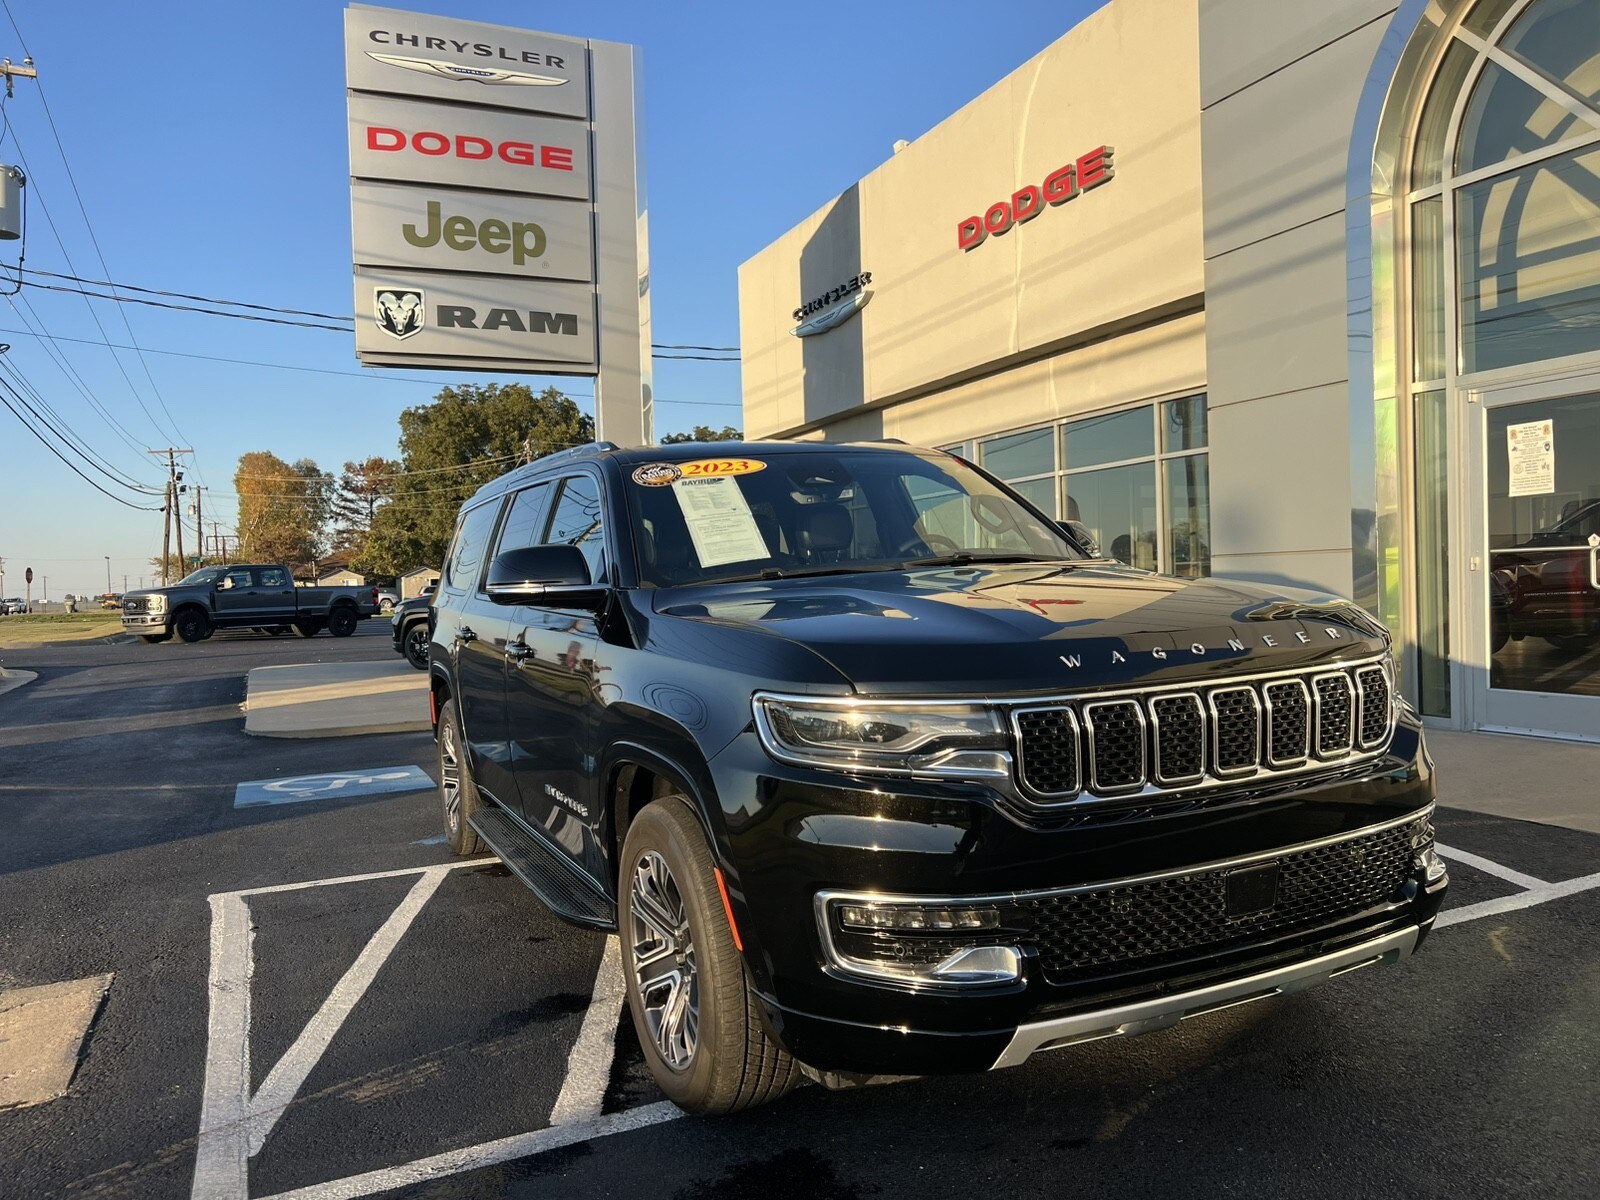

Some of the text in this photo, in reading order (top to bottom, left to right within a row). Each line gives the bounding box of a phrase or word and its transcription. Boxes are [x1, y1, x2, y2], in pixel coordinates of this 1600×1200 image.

[369, 30, 565, 69] CHRYSLER
[367, 126, 573, 171] DODGE
[957, 144, 1113, 252] DODGE
[402, 201, 547, 266] Jeep
[793, 271, 872, 321] CHRYSLER
[436, 304, 578, 336] RAM
[687, 461, 749, 475] 2023
[1059, 627, 1341, 669] WAGONEER
